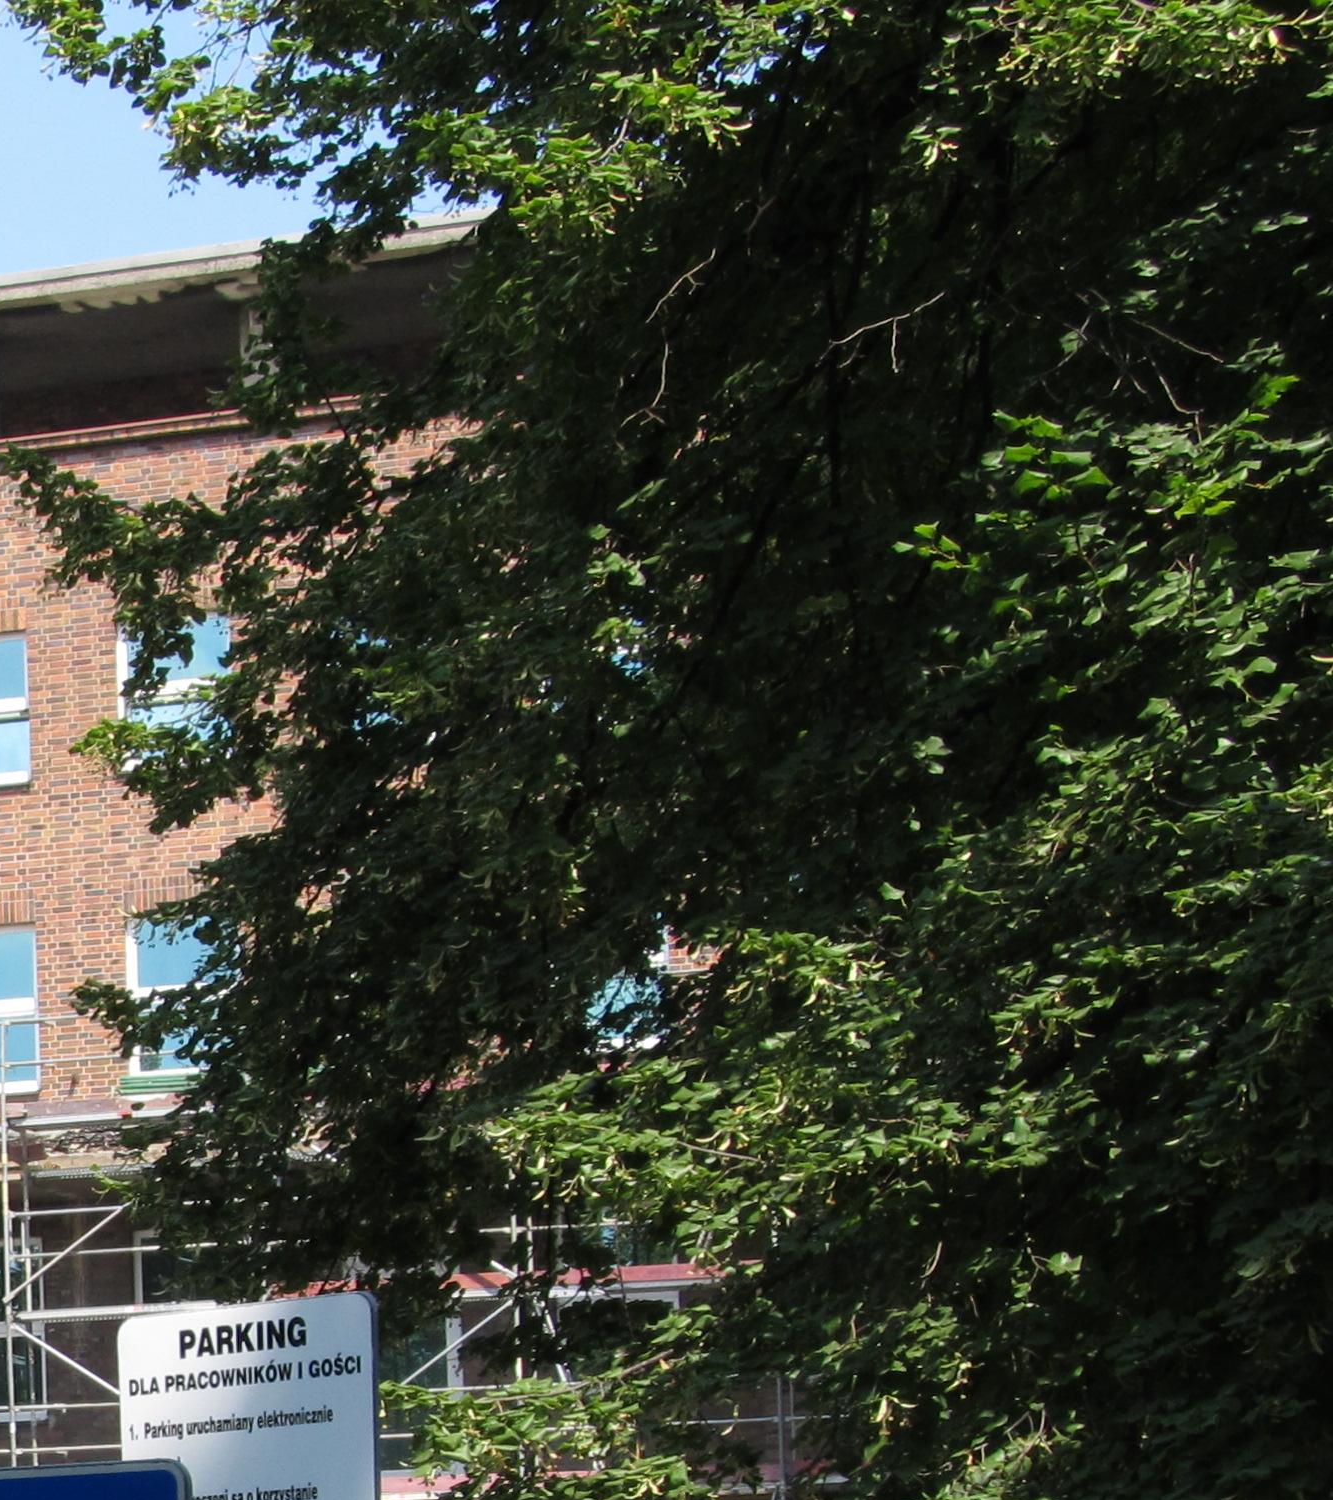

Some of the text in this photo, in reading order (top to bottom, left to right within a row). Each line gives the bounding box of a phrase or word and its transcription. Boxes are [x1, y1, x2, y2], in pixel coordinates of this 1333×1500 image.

[179, 1316, 308, 1359] PARKING
[129, 1353, 361, 1397] DLA PRACOWNIKÓW I GOŚCI
[130, 1405, 333, 1441] 1. Parking uruchamiany elektronicznie
